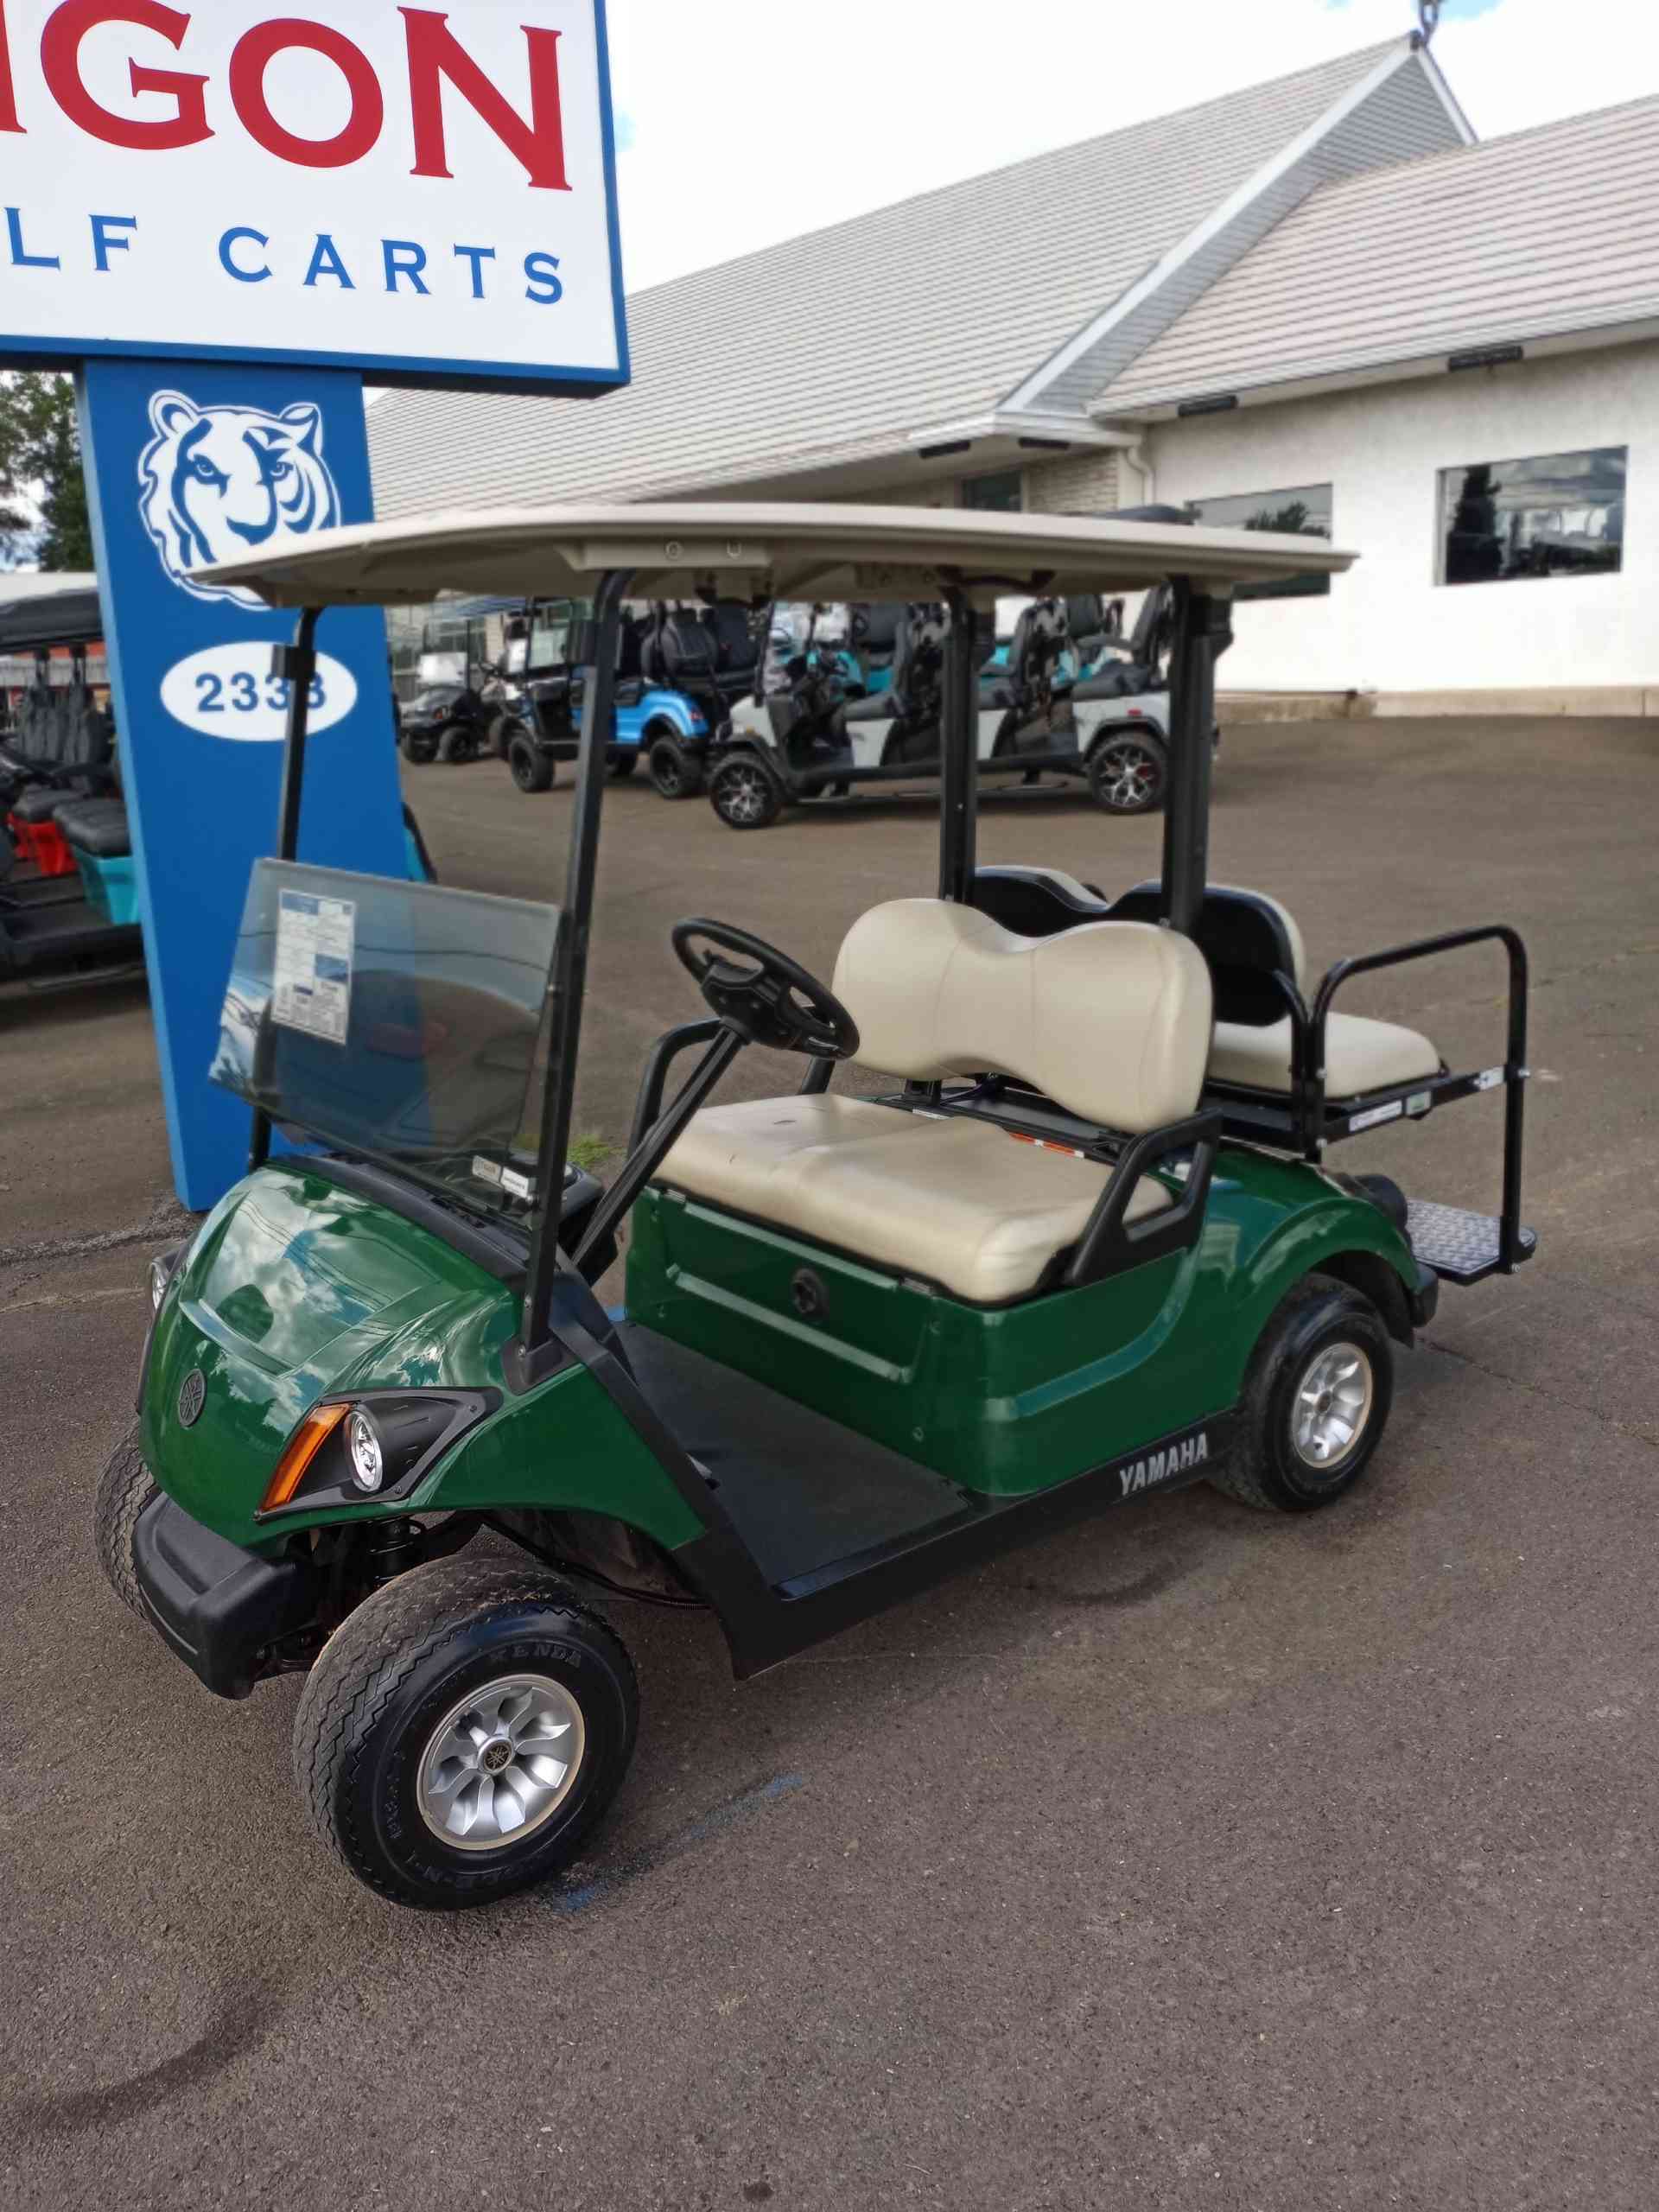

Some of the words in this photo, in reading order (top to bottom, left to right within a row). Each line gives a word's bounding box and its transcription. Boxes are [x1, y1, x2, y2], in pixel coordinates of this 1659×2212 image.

[4, 207, 137, 271] LF
[218, 226, 564, 305] CARTS
[1119, 1432, 1208, 1496] YAMAHA
